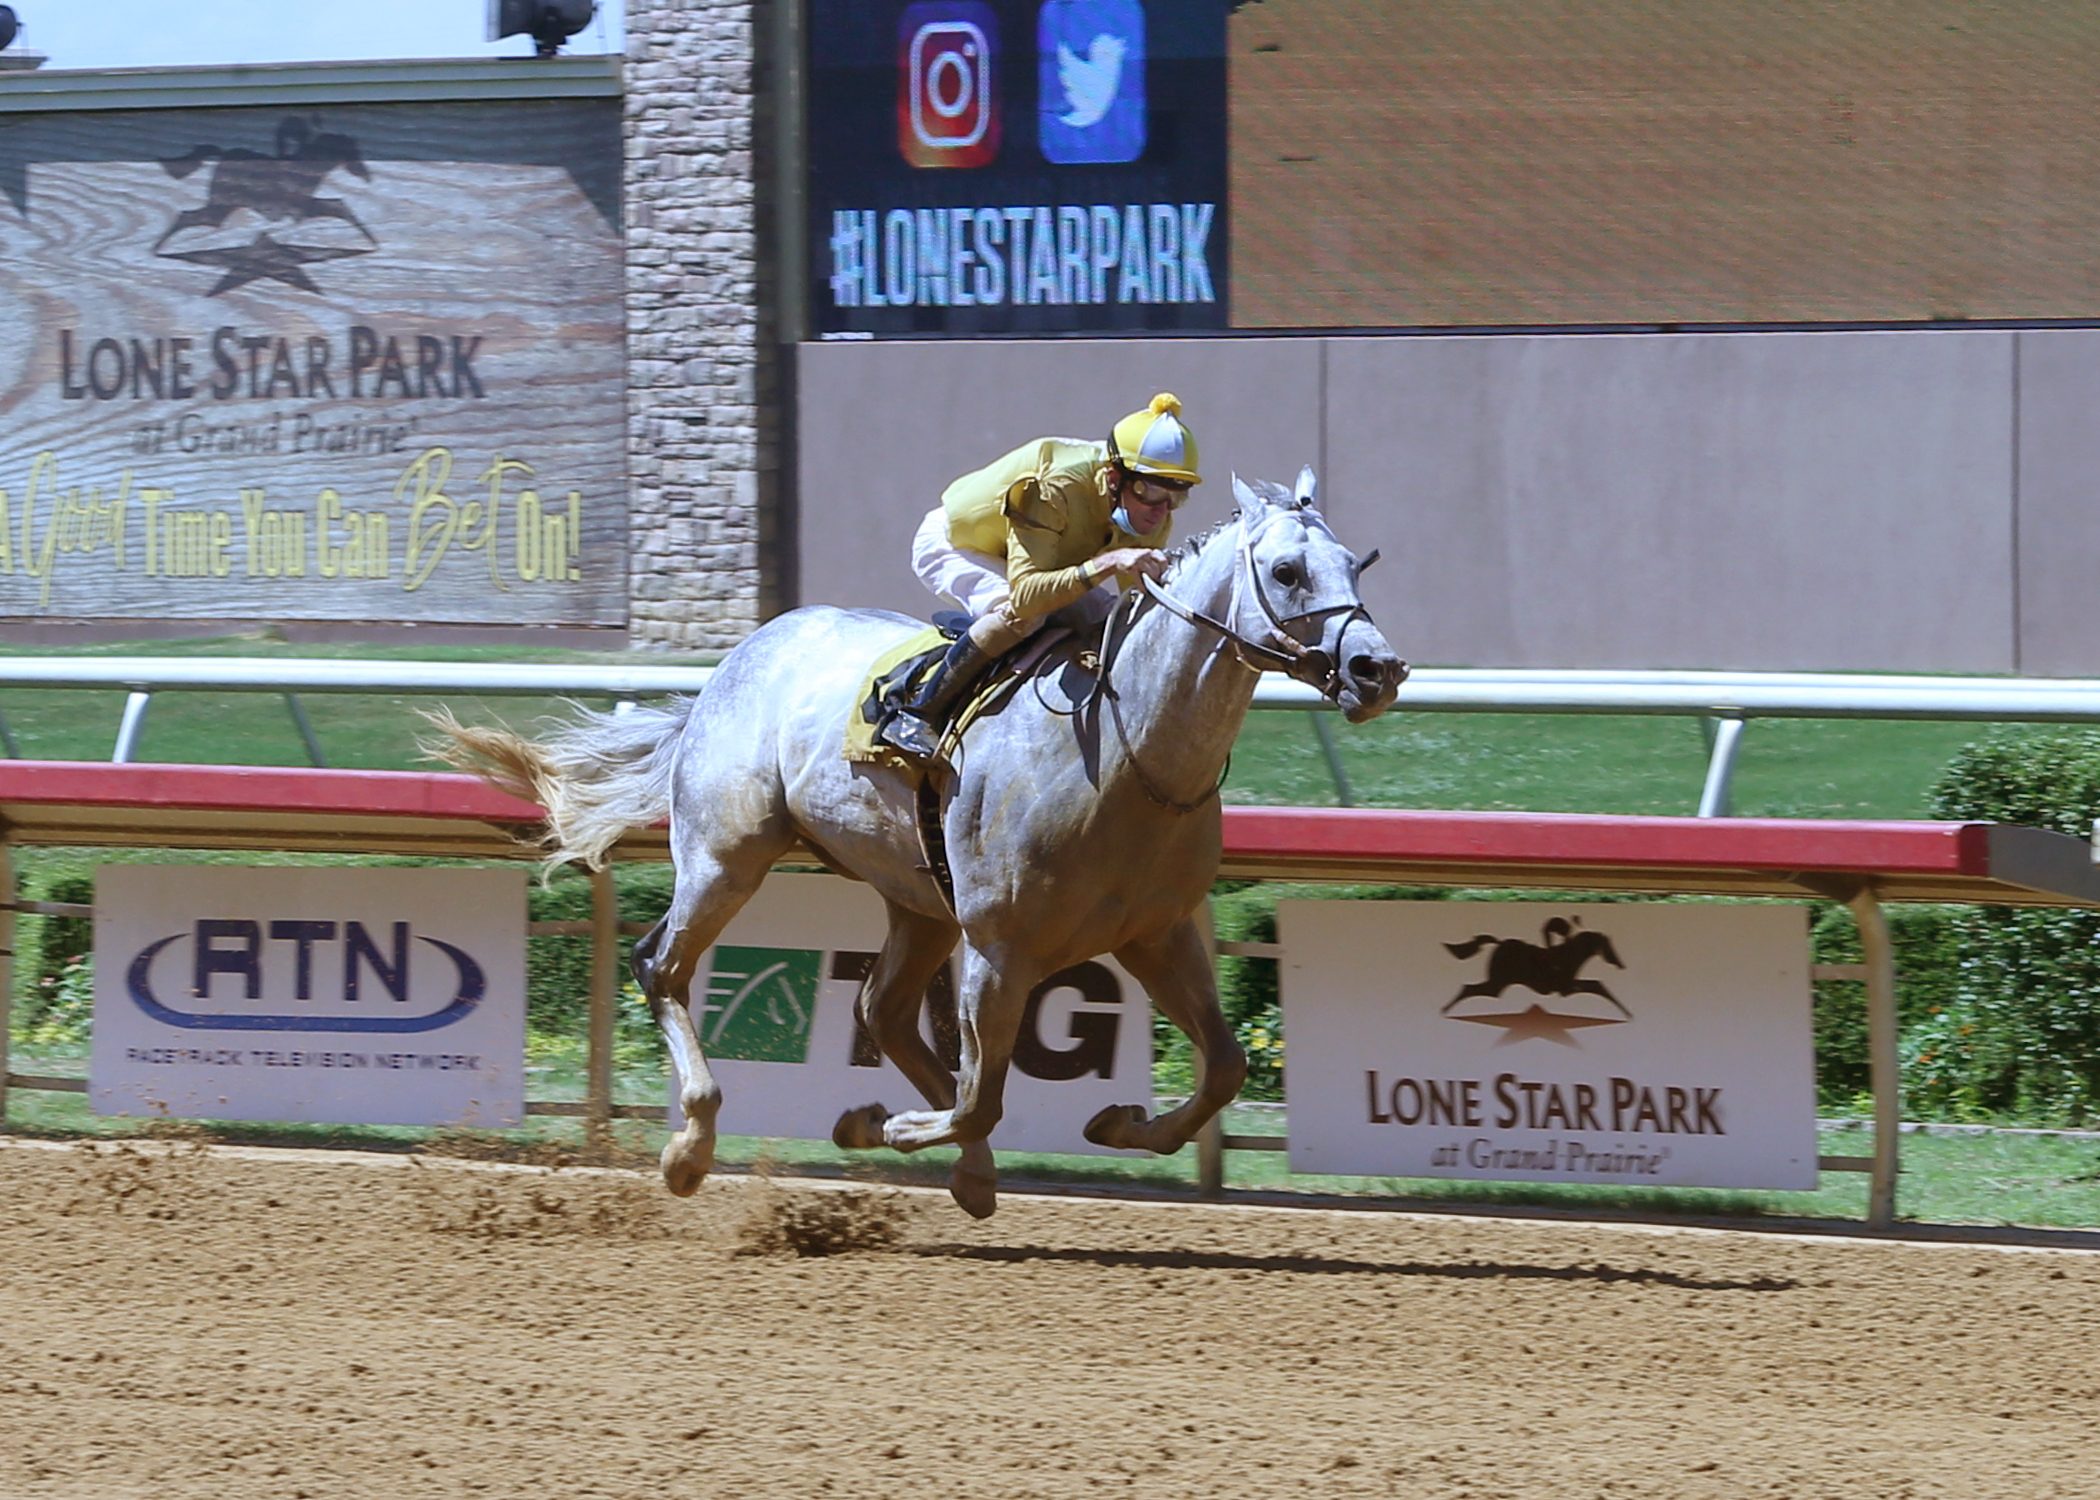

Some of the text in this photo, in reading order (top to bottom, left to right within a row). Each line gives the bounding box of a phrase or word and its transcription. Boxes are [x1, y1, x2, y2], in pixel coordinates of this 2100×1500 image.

[831, 203, 1215, 307] #LONESTARPARK
[61, 325, 485, 400] LONE STAR PARK
[177, 412, 280, 453] Grand
[139, 487, 230, 577] Time
[239, 487, 305, 577] You
[316, 488, 389, 578] Can
[394, 446, 535, 592] Bet
[516, 489, 581, 581] On!
[195, 919, 410, 1002] RTN
[126, 1047, 482, 1071] RACETRACK TELEVISION NETWORK
[1366, 1070, 1726, 1136] LONE STAR PARK
[1431, 1143, 1461, 1168] at
[1466, 1138, 1558, 1171] Grand
